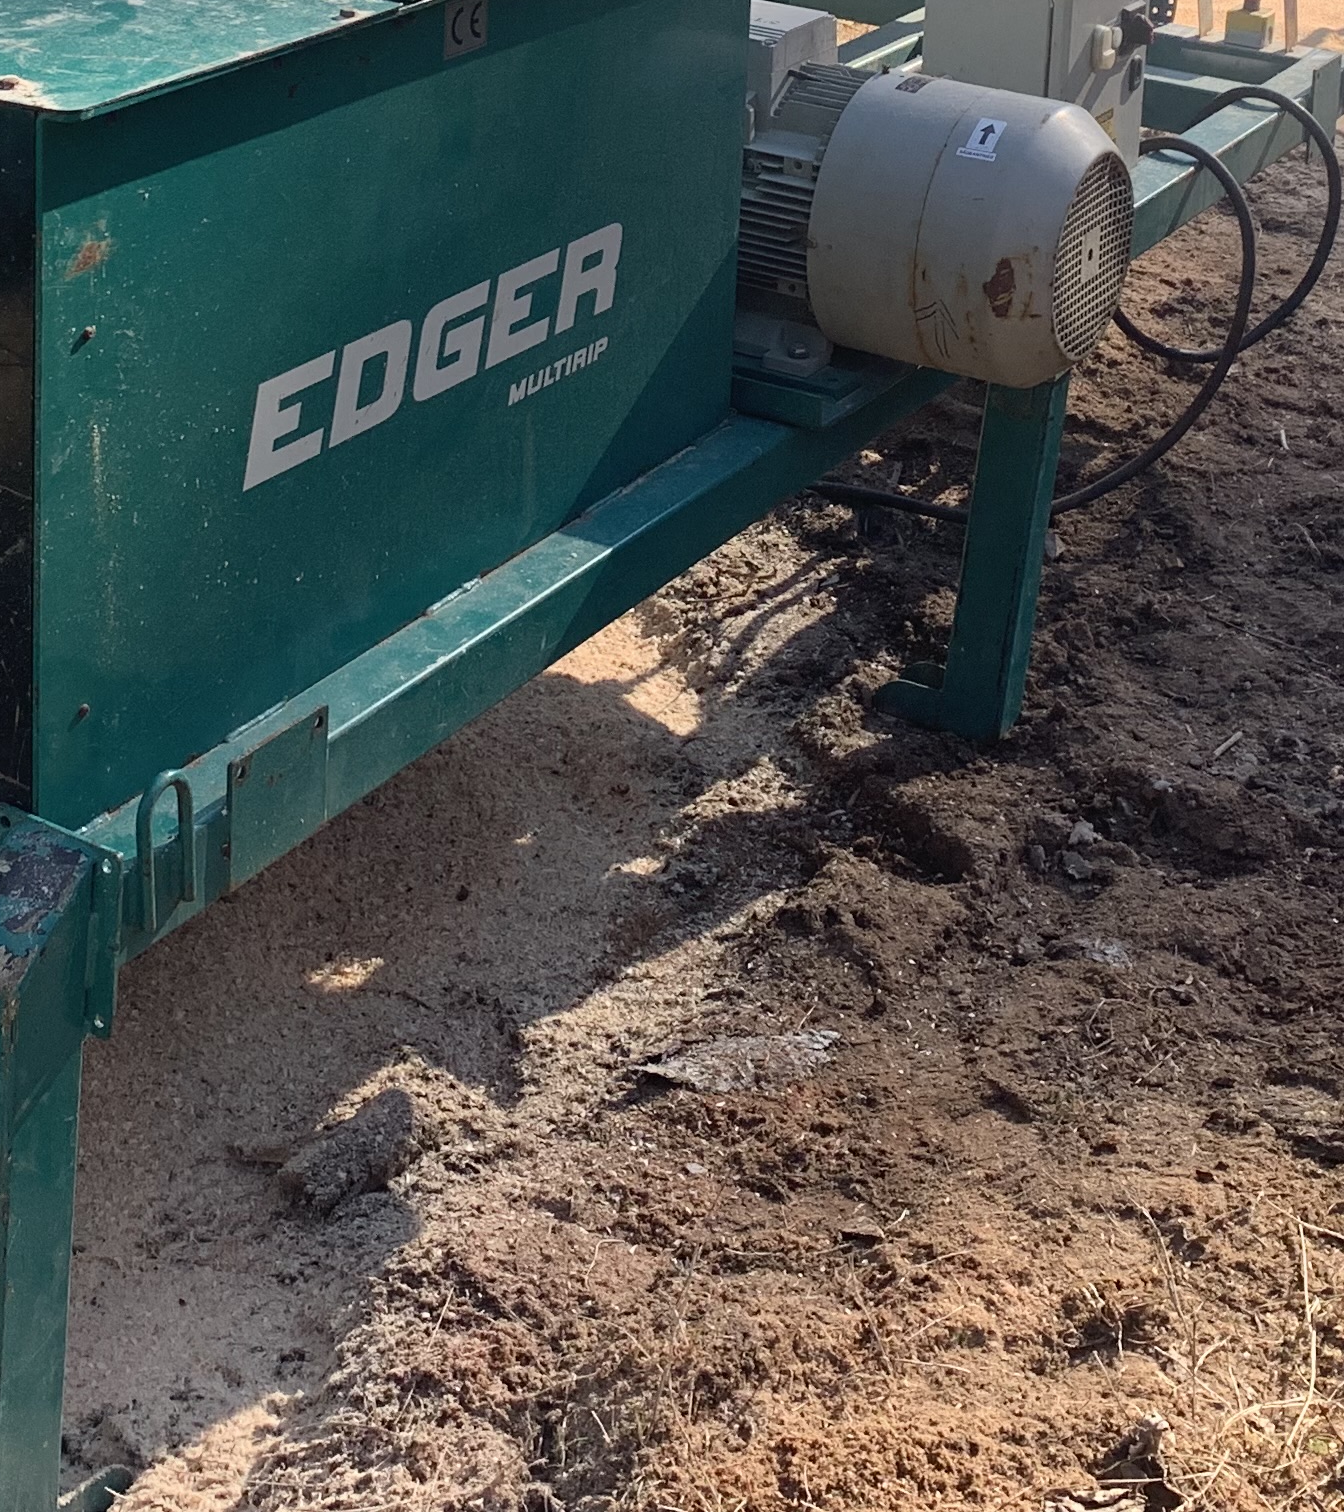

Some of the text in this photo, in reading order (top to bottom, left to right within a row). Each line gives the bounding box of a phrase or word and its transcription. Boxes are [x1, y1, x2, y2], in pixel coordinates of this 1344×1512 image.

[452, 0, 483, 45] CE
[243, 222, 623, 492] EDGER
[508, 336, 608, 407] MULTIRIP
